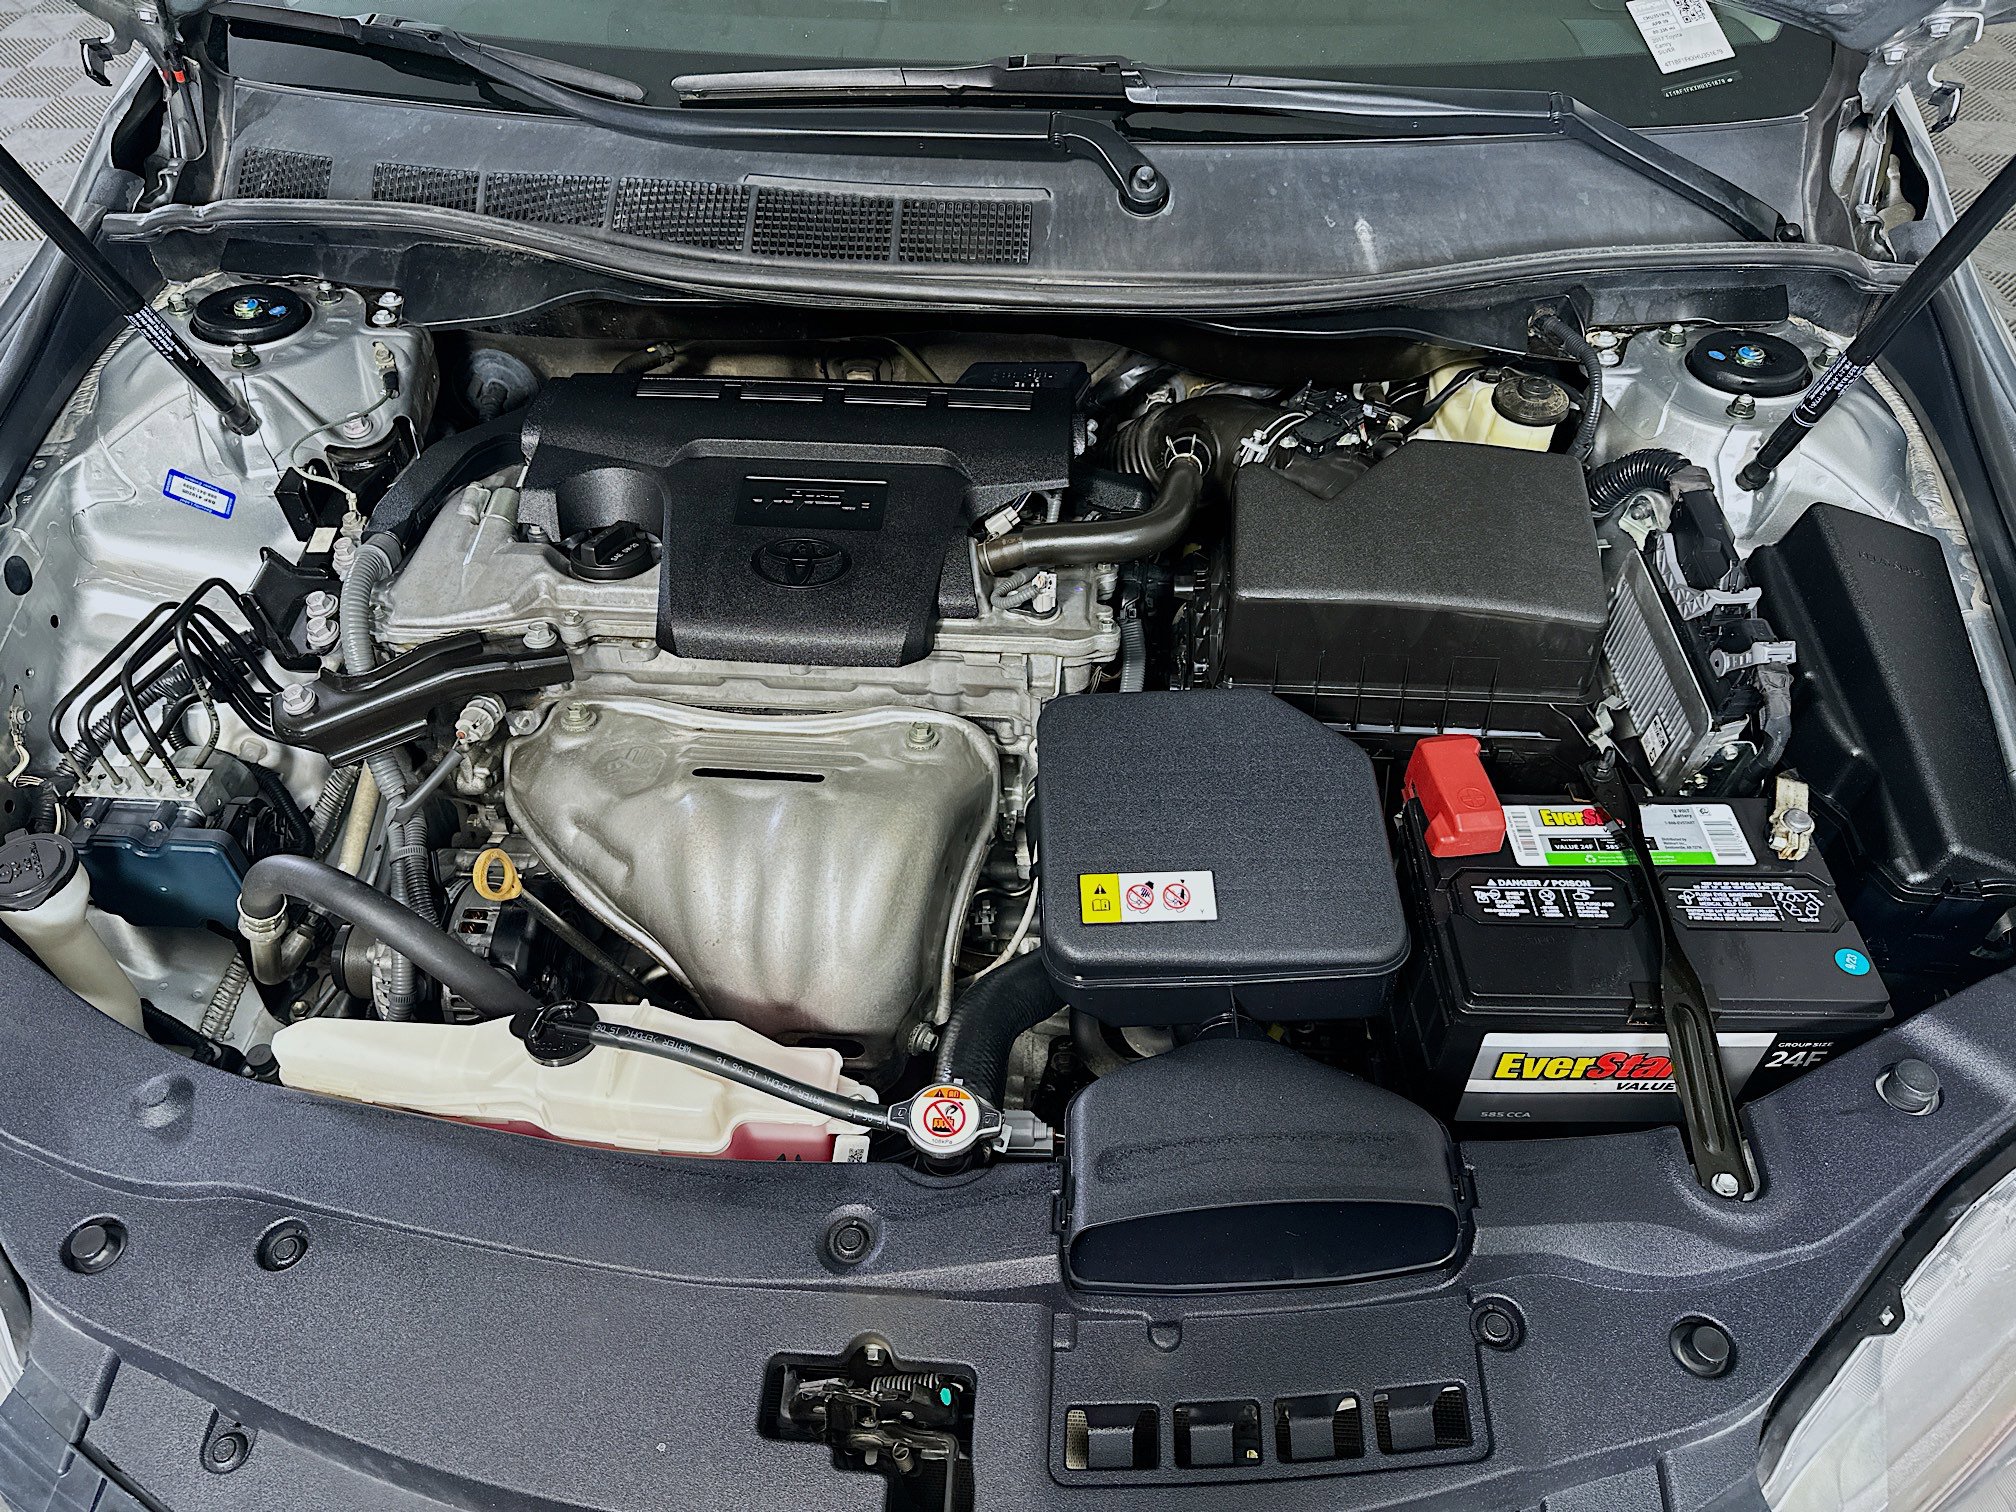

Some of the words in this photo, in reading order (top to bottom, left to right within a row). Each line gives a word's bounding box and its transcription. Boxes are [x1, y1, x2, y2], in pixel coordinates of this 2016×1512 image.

[1497, 879, 1542, 887] DANGER
[662, 1038, 692, 1053] WATER
[1492, 1051, 1674, 1080] EverSta
[1764, 1050, 1829, 1068] 24F
[1616, 1082, 1676, 1091] VALUE
